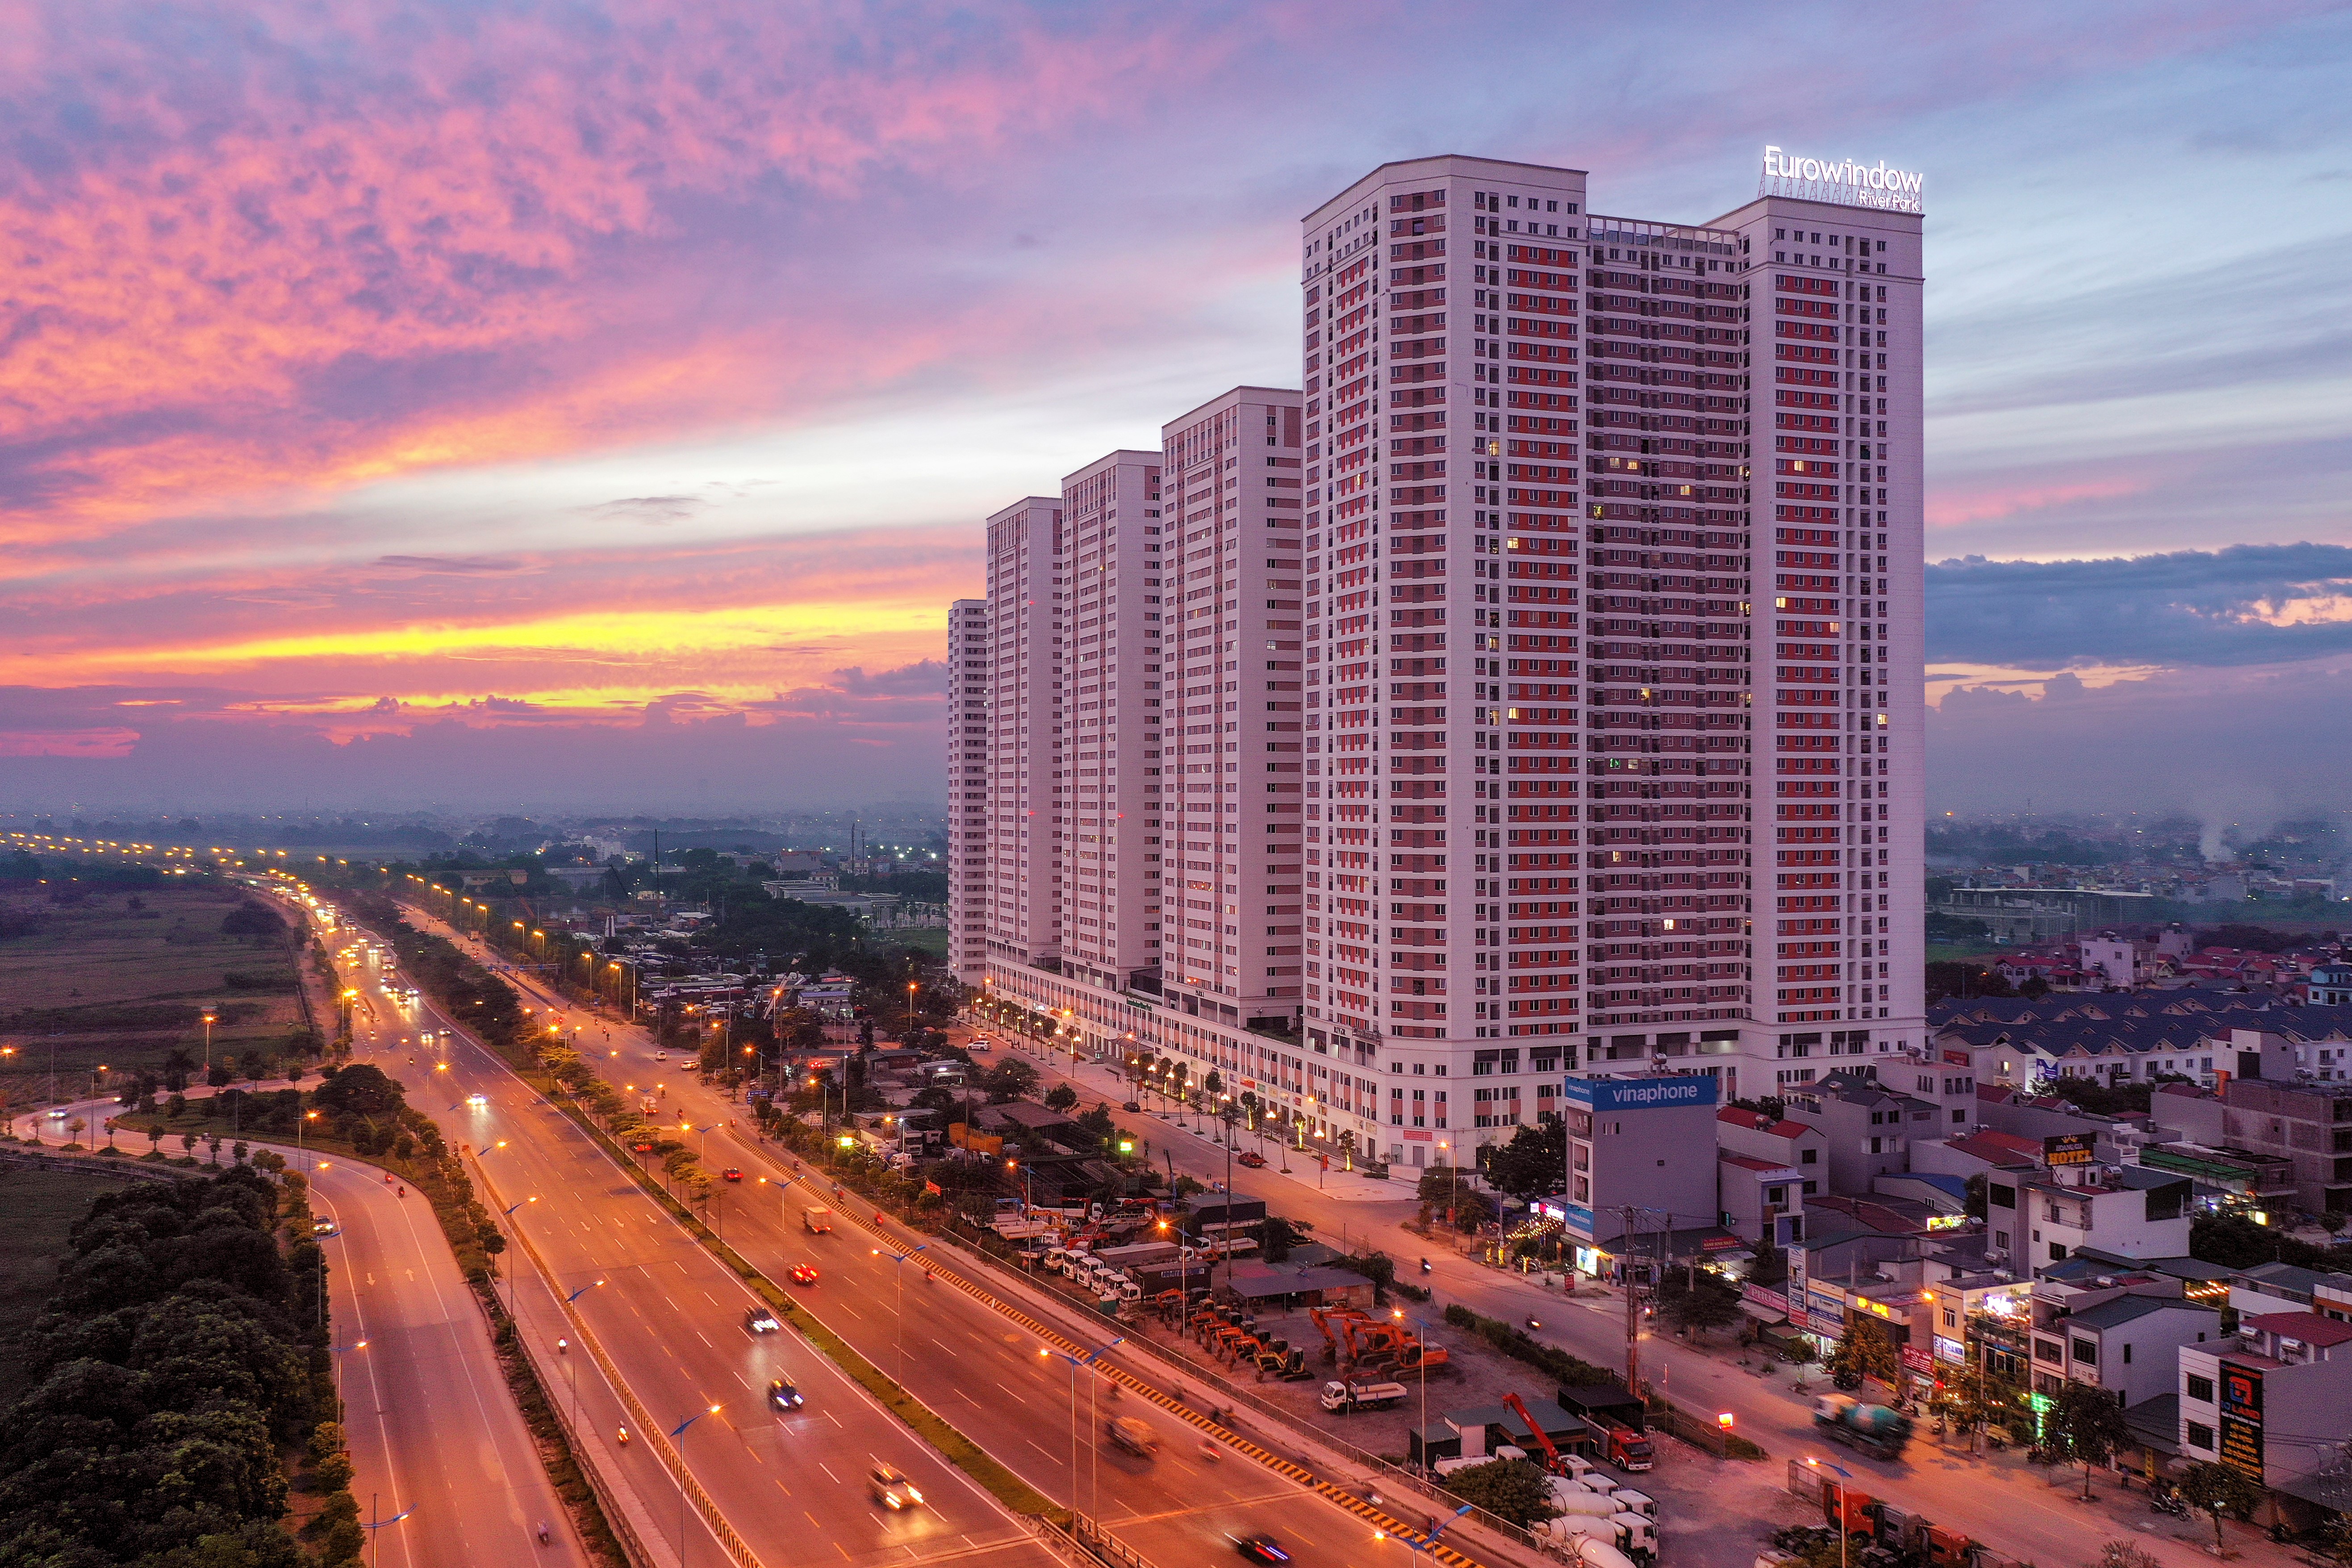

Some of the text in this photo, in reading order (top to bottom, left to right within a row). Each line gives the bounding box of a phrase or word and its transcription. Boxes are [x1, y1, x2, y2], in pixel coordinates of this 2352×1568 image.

[1763, 145, 1923, 193] Eurowindow
[1859, 191, 1919, 211] River Park
[1567, 1083, 1590, 1095] vinaphone
[1613, 1083, 1698, 1103] vinaphone
[2047, 1150, 2093, 1165] HOTEL
